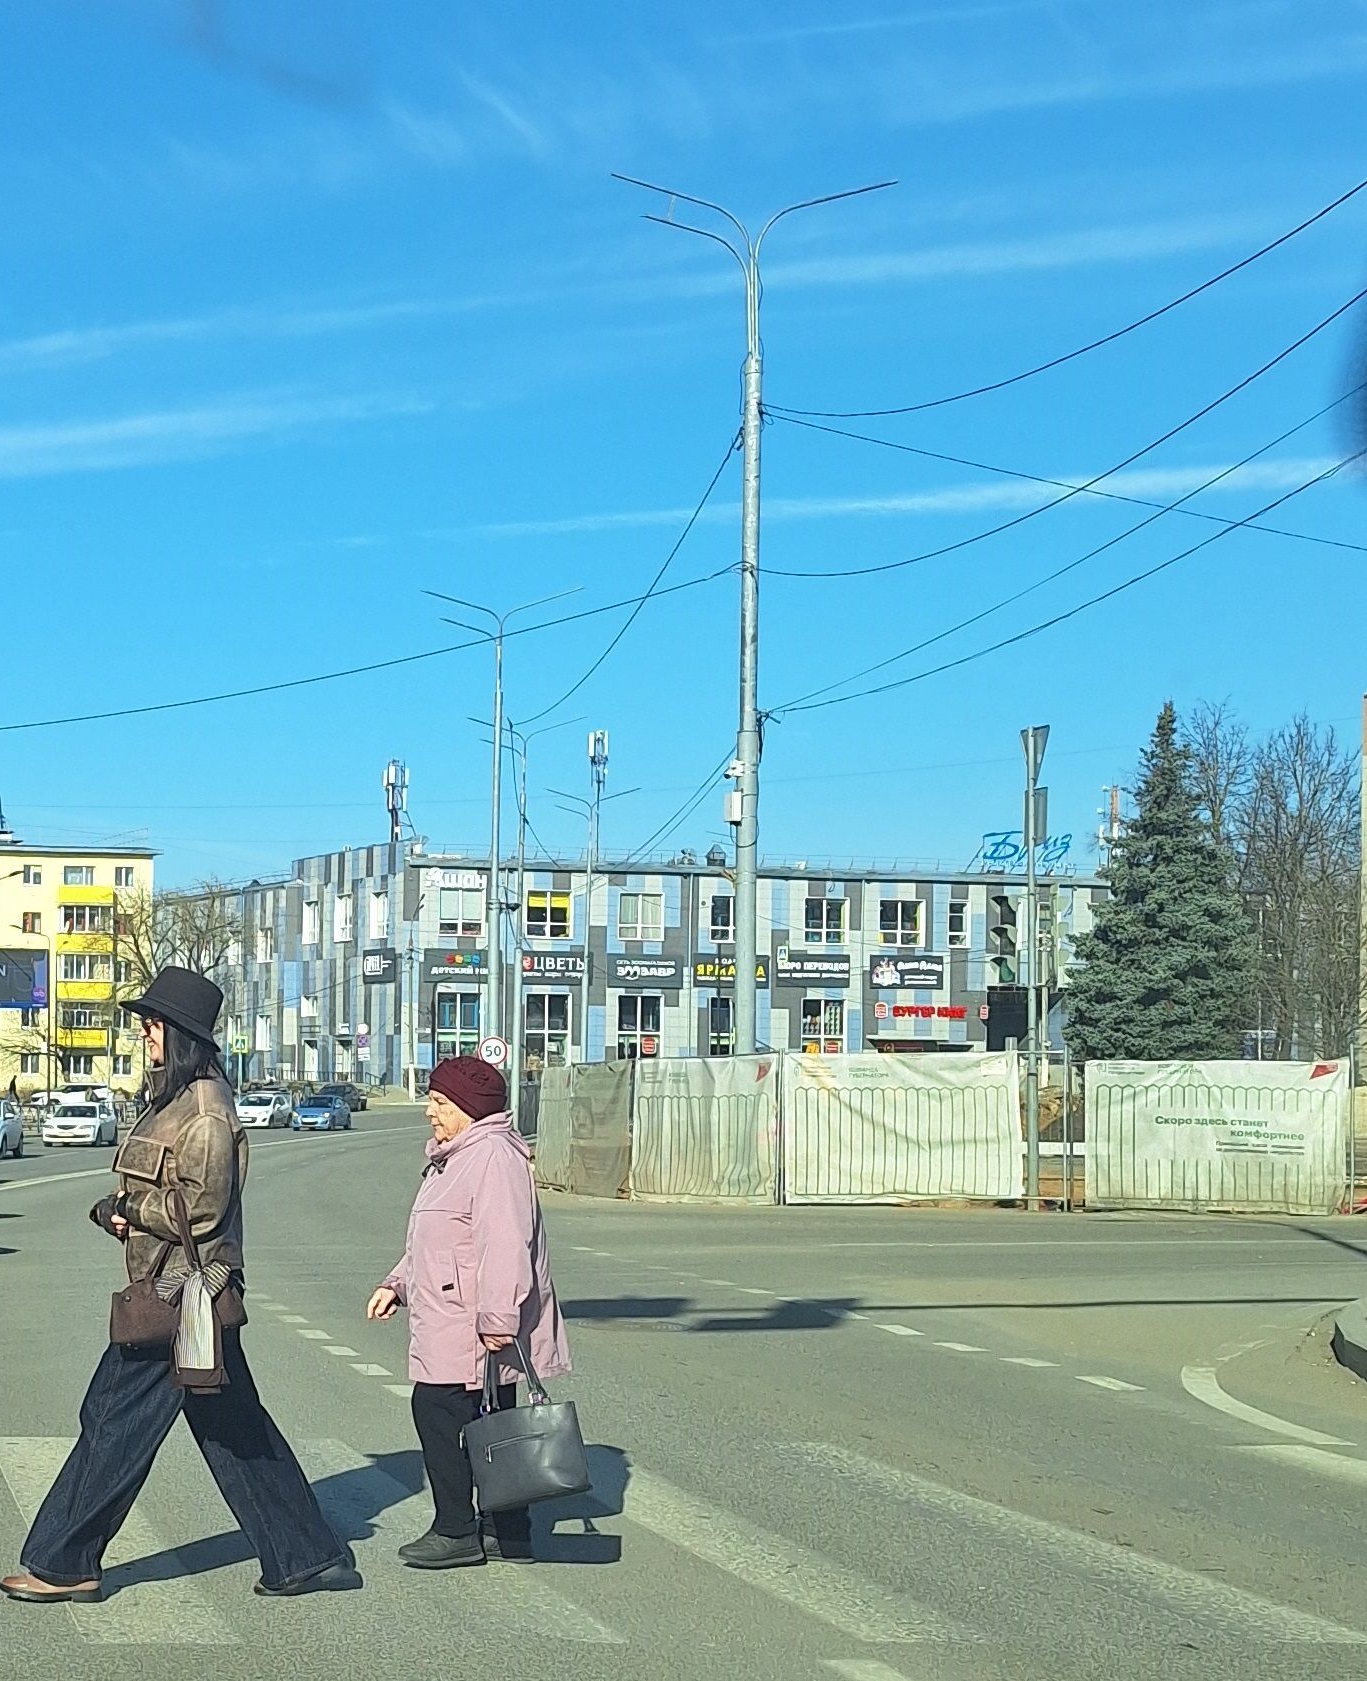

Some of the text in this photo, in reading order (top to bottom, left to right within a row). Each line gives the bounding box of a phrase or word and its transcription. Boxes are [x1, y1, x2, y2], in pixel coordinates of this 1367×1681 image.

[697, 963, 765, 977] ЯРМАА
[485, 1045, 502, 1057] 50
[1154, 1115, 1192, 1126] Скоро
[1194, 1117, 1228, 1127] здесь
